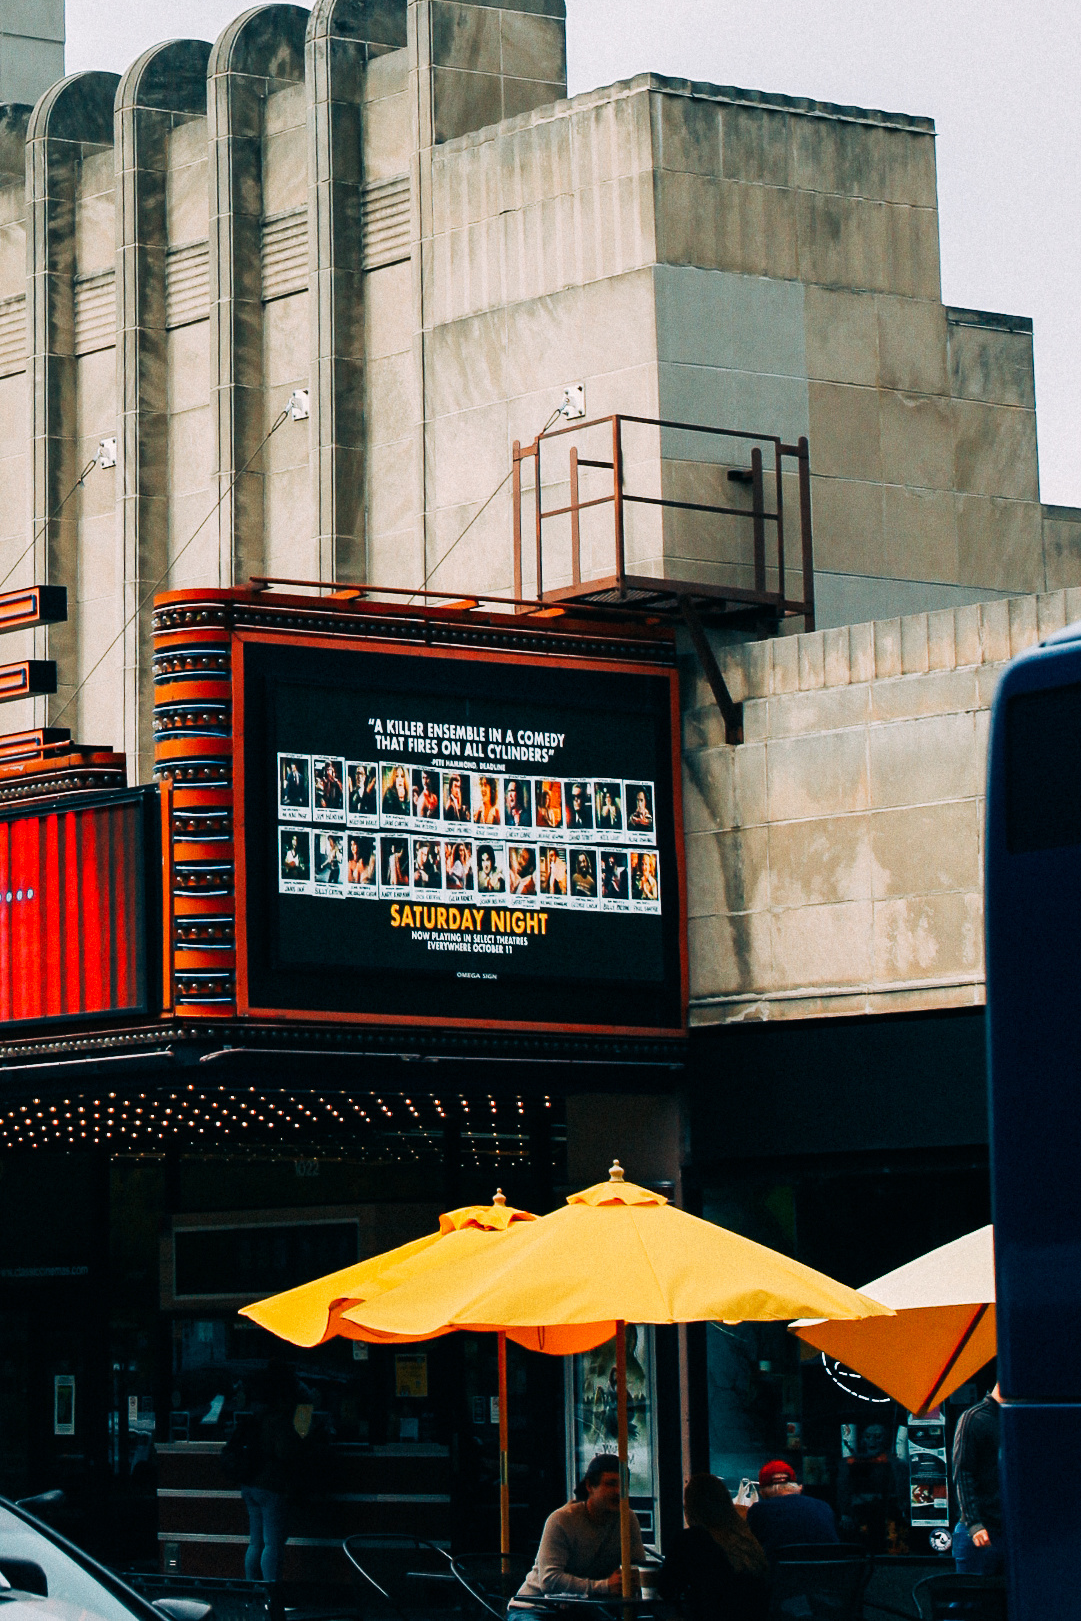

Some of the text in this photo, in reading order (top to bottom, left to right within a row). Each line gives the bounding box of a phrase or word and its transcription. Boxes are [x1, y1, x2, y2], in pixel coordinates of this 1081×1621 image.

[386, 719, 424, 737] KILLER
[427, 723, 486, 742] ENSEMBLE
[488, 727, 502, 743] IN
[505, 730, 515, 744] A
[517, 730, 565, 748] COMEDY
[375, 735, 404, 751] THAT
[407, 737, 438, 754] FIRES
[441, 741, 461, 756] ON
[464, 743, 485, 758] ALL
[479, 762, 506, 772] DEADLINE
[390, 904, 549, 935] SATURDAY NIGHT
[411, 931, 529, 946] NOW PLAYING IN SELECT THEATRES
[427, 941, 513, 954] EVERYWHERE OCTOBER 11
[456, 971, 481, 979] OMEGA
